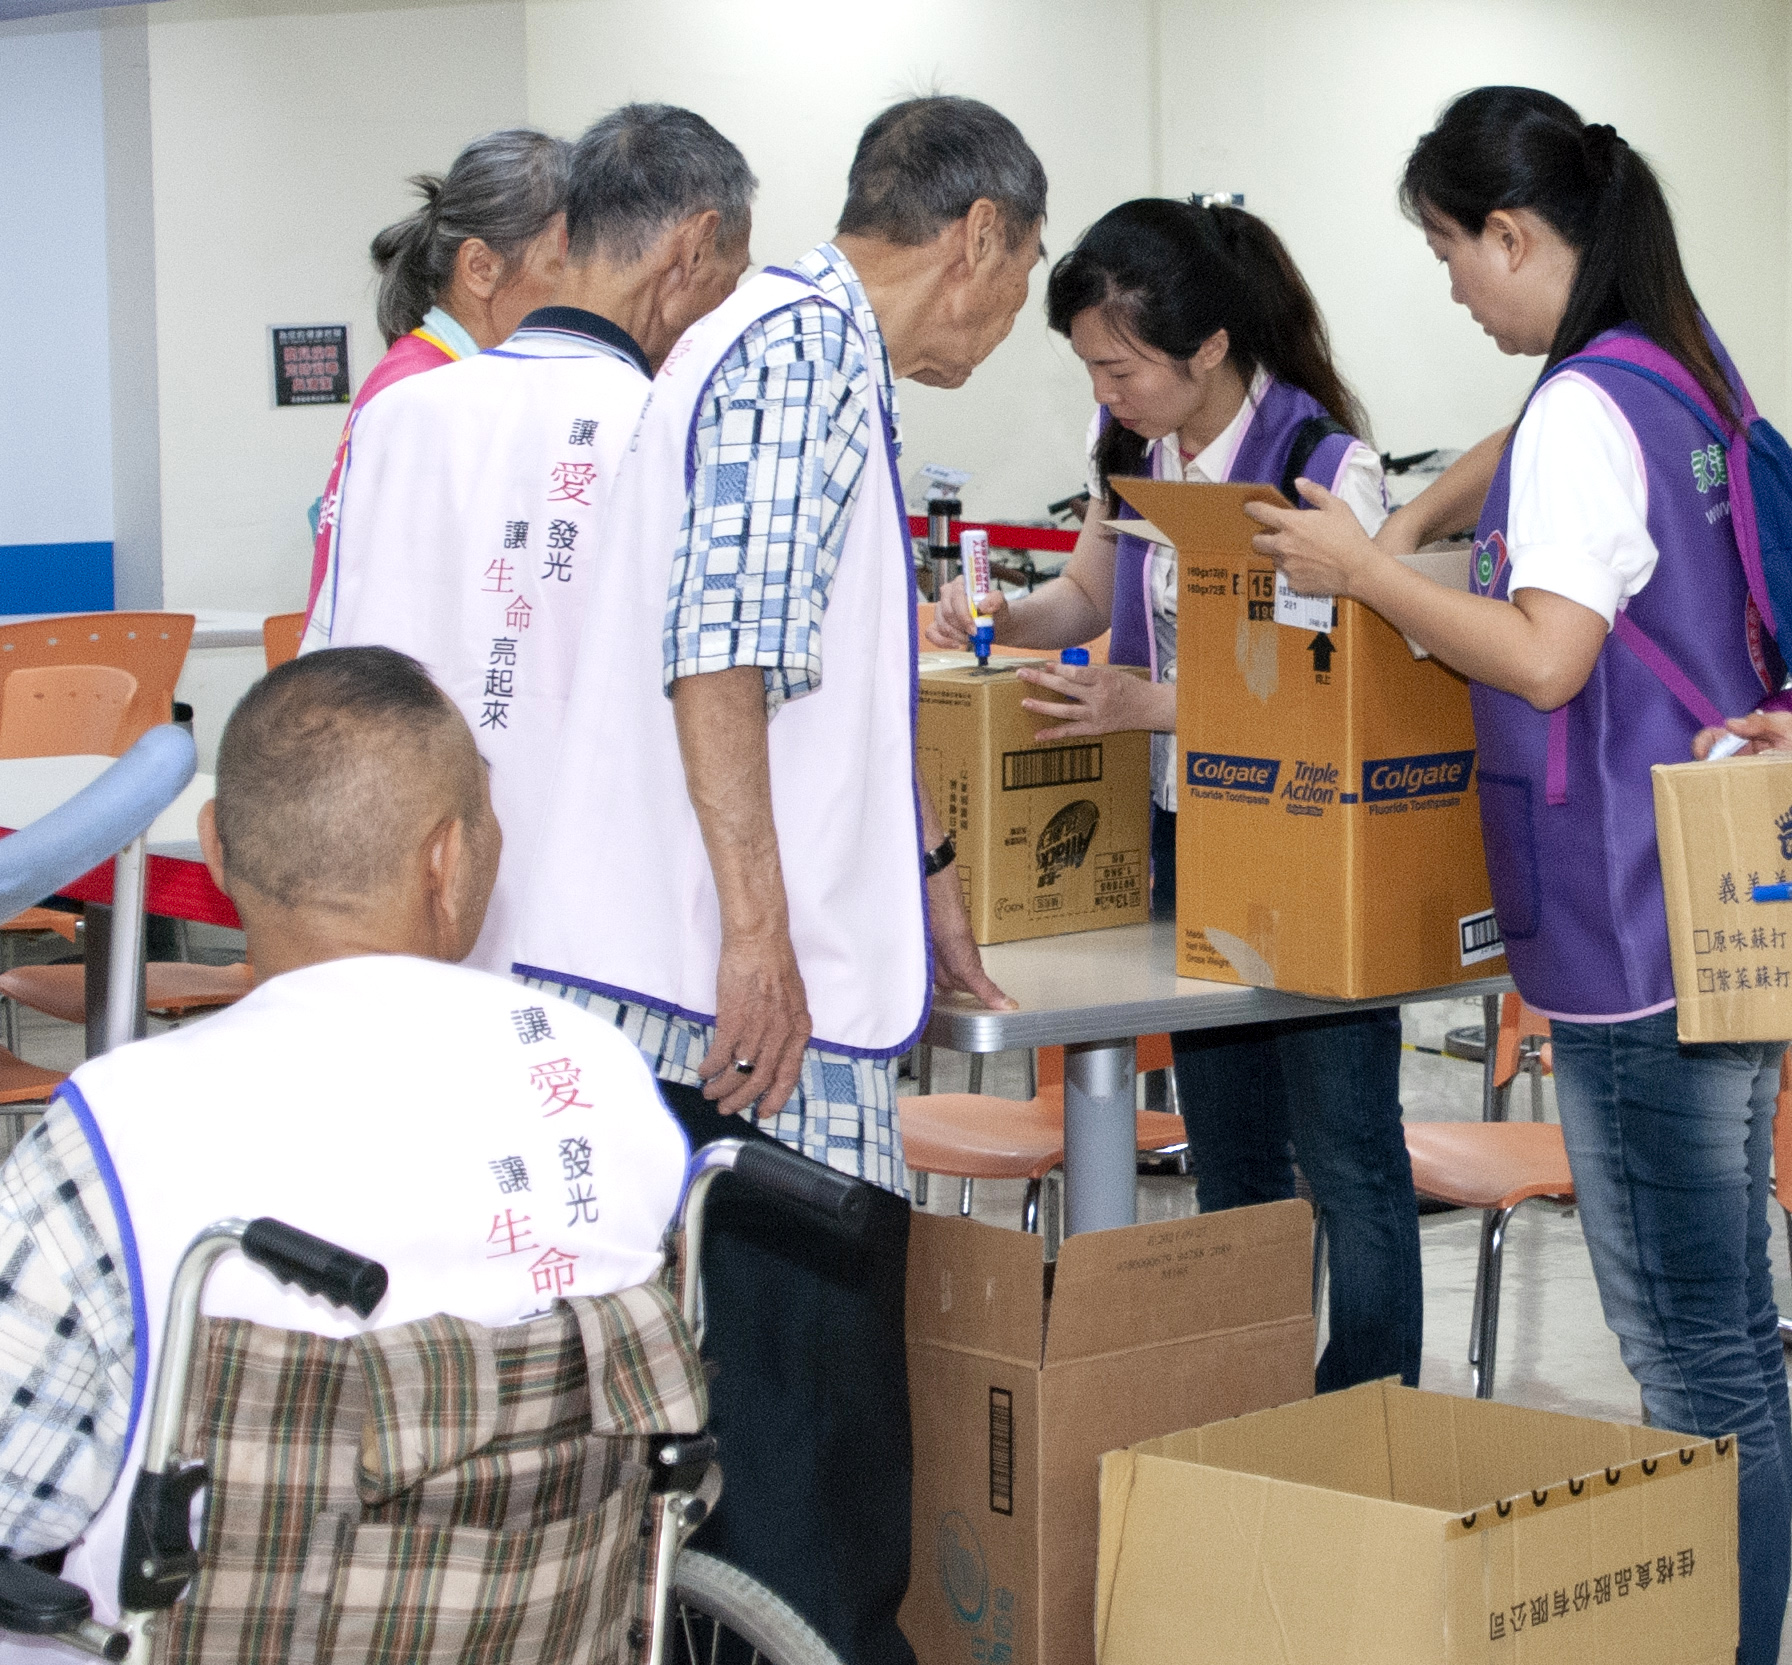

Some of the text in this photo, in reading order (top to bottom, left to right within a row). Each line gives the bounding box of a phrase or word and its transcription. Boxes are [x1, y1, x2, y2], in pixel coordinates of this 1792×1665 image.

[1191, 757, 1270, 786] Colgate
[1294, 760, 1340, 785] Triple
[1369, 763, 1463, 793] Colgate
[1189, 787, 1270, 806] Fluoride Toothpaste
[1279, 780, 1334, 806] Action
[1368, 796, 1461, 816] Fluoride Toothpaste
[1712, 927, 1787, 953] 原味蘇打
[1716, 965, 1791, 992] 紫菜蘇打
[1489, 1548, 1696, 1641] 佳格食品股份有限公司
